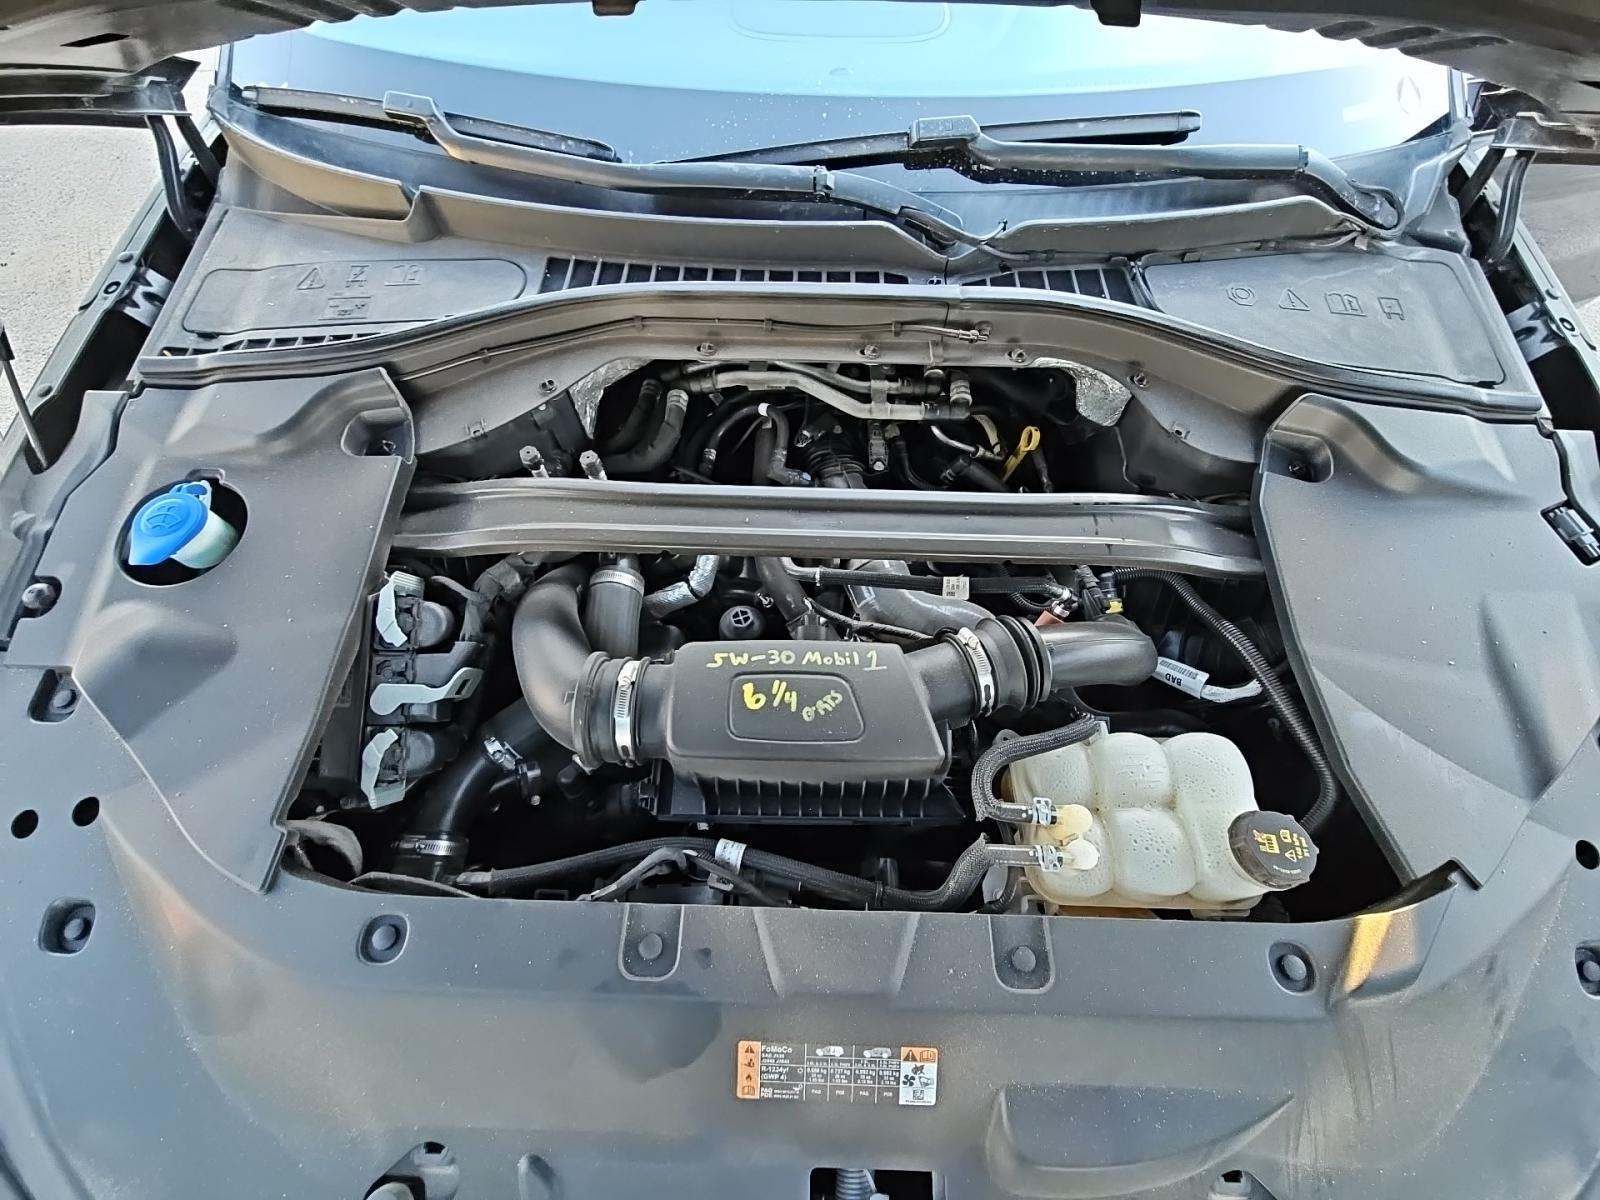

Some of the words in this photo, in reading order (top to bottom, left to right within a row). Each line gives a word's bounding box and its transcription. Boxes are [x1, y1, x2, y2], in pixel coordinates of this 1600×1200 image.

[706, 650, 796, 668] 5W-30
[802, 651, 860, 666] Mobil
[862, 650, 887, 671] 1
[1165, 672, 1183, 687] BAD
[742, 682, 767, 710] 6
[772, 679, 798, 712] 1/4
[761, 1045, 793, 1054] FoMoCo
[761, 1065, 789, 1074] R-1234yf
